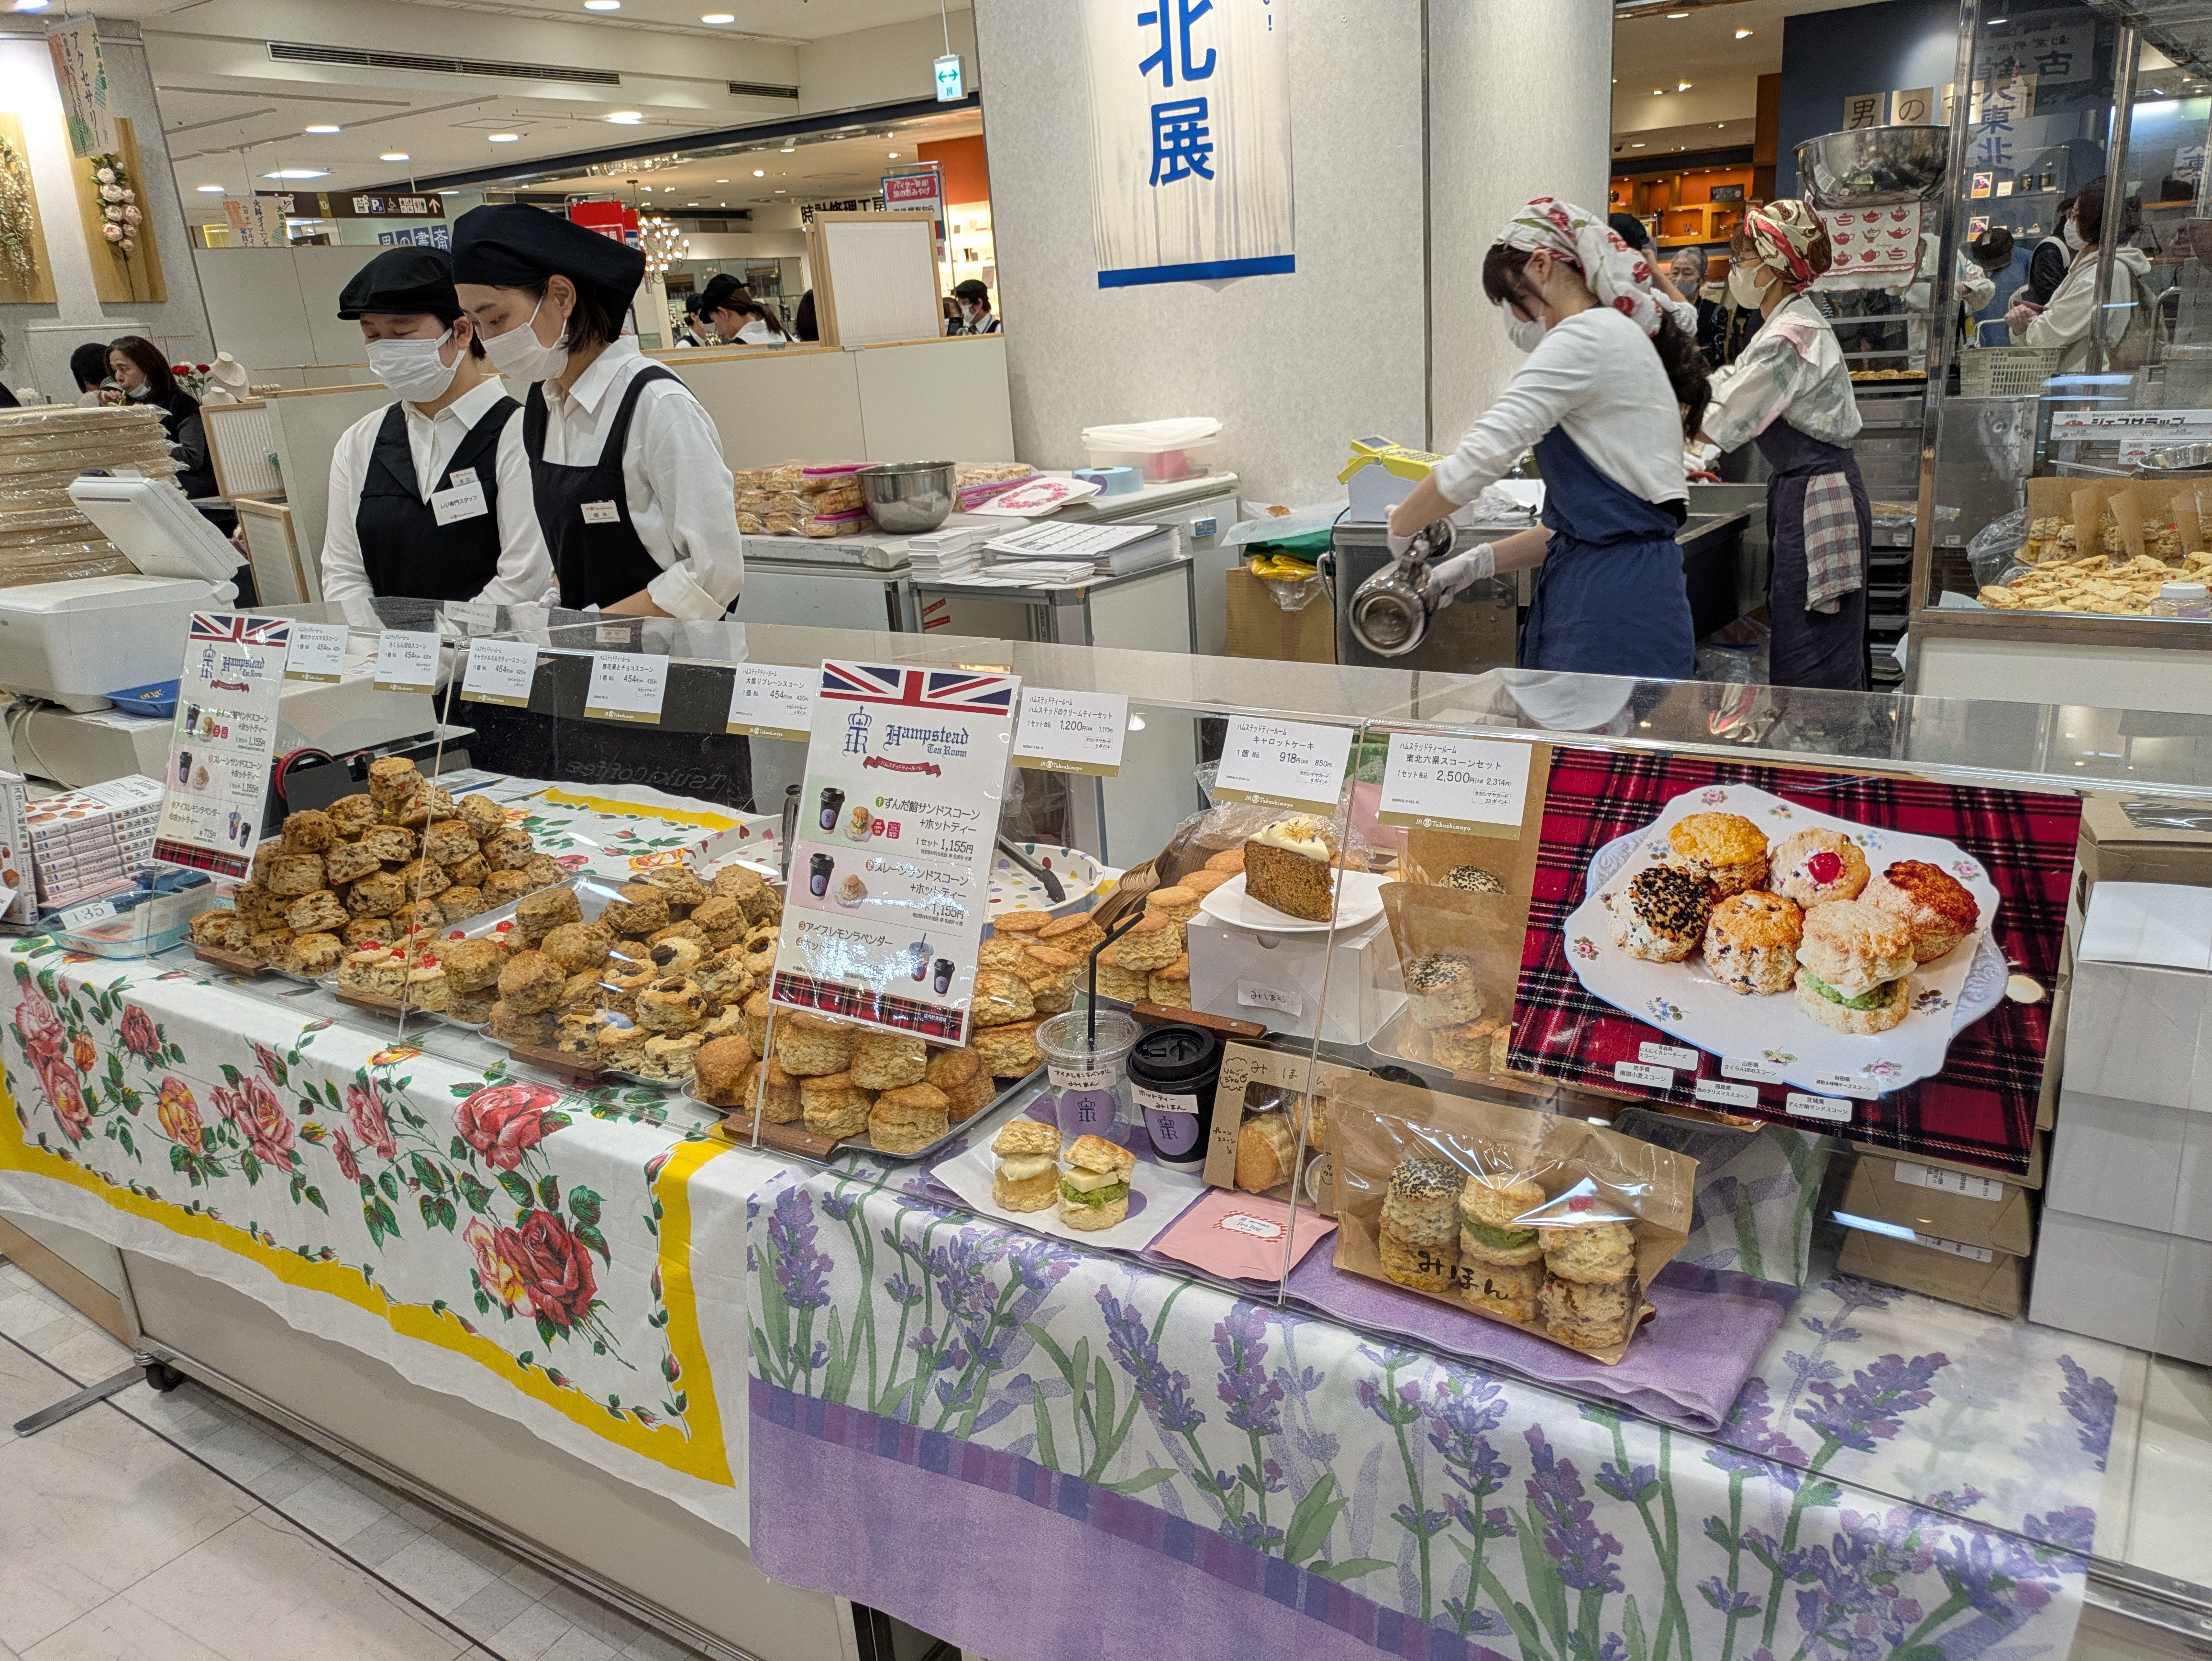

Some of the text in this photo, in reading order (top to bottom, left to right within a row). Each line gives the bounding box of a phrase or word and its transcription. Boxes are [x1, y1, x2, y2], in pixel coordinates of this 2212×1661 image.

[1030, 696, 1073, 706] ハムステッドティールーム
[1028, 706, 1112, 720] ハムステッドのクリームティーセット
[1237, 723, 1286, 735] ハムステッドティールーム
[883, 723, 969, 751] Hampstead
[1253, 736, 1315, 751] キャロットケーキ
[1400, 742, 1456, 754] ハムステッドティールーム
[927, 743, 967, 758] Tea Room
[1237, 749, 1249, 757] 1個
[881, 760, 923, 771] ハムステッドティールーム
[1053, 762, 1083, 772] Takashimaya
[1405, 754, 1502, 770] 東北六県スコーンセット
[1475, 791, 1509, 799] タカシマヤカード
[885, 797, 980, 820] ずんだ餡サンドスコーン
[1260, 797, 1293, 808] Takashimaya
[919, 819, 977, 834] +ホットティー
[1432, 820, 1471, 831] Takashimaya
[940, 838, 974, 854] 1,155円
[805, 922, 894, 947] アイスレモンラベンダー
[1250, 990, 1286, 1003] みほん
[923, 1013, 948, 1023] 店内飲食価格
[1639, 1047, 1687, 1060] にんにくカレーチーズ
[1620, 1070, 1666, 1082] 南部小麦スコーン
[1724, 1064, 1777, 1076] さくらんぼのスコーン
[1139, 1089, 1176, 1102] ホットティー
[1697, 1087, 1749, 1099] 桃のクリスマススコーン
[1155, 1102, 1186, 1111] みほん
[1788, 1101, 1847, 1115] ずんだ餡サンドスコーン
[1416, 1250, 1509, 1301] みほん
